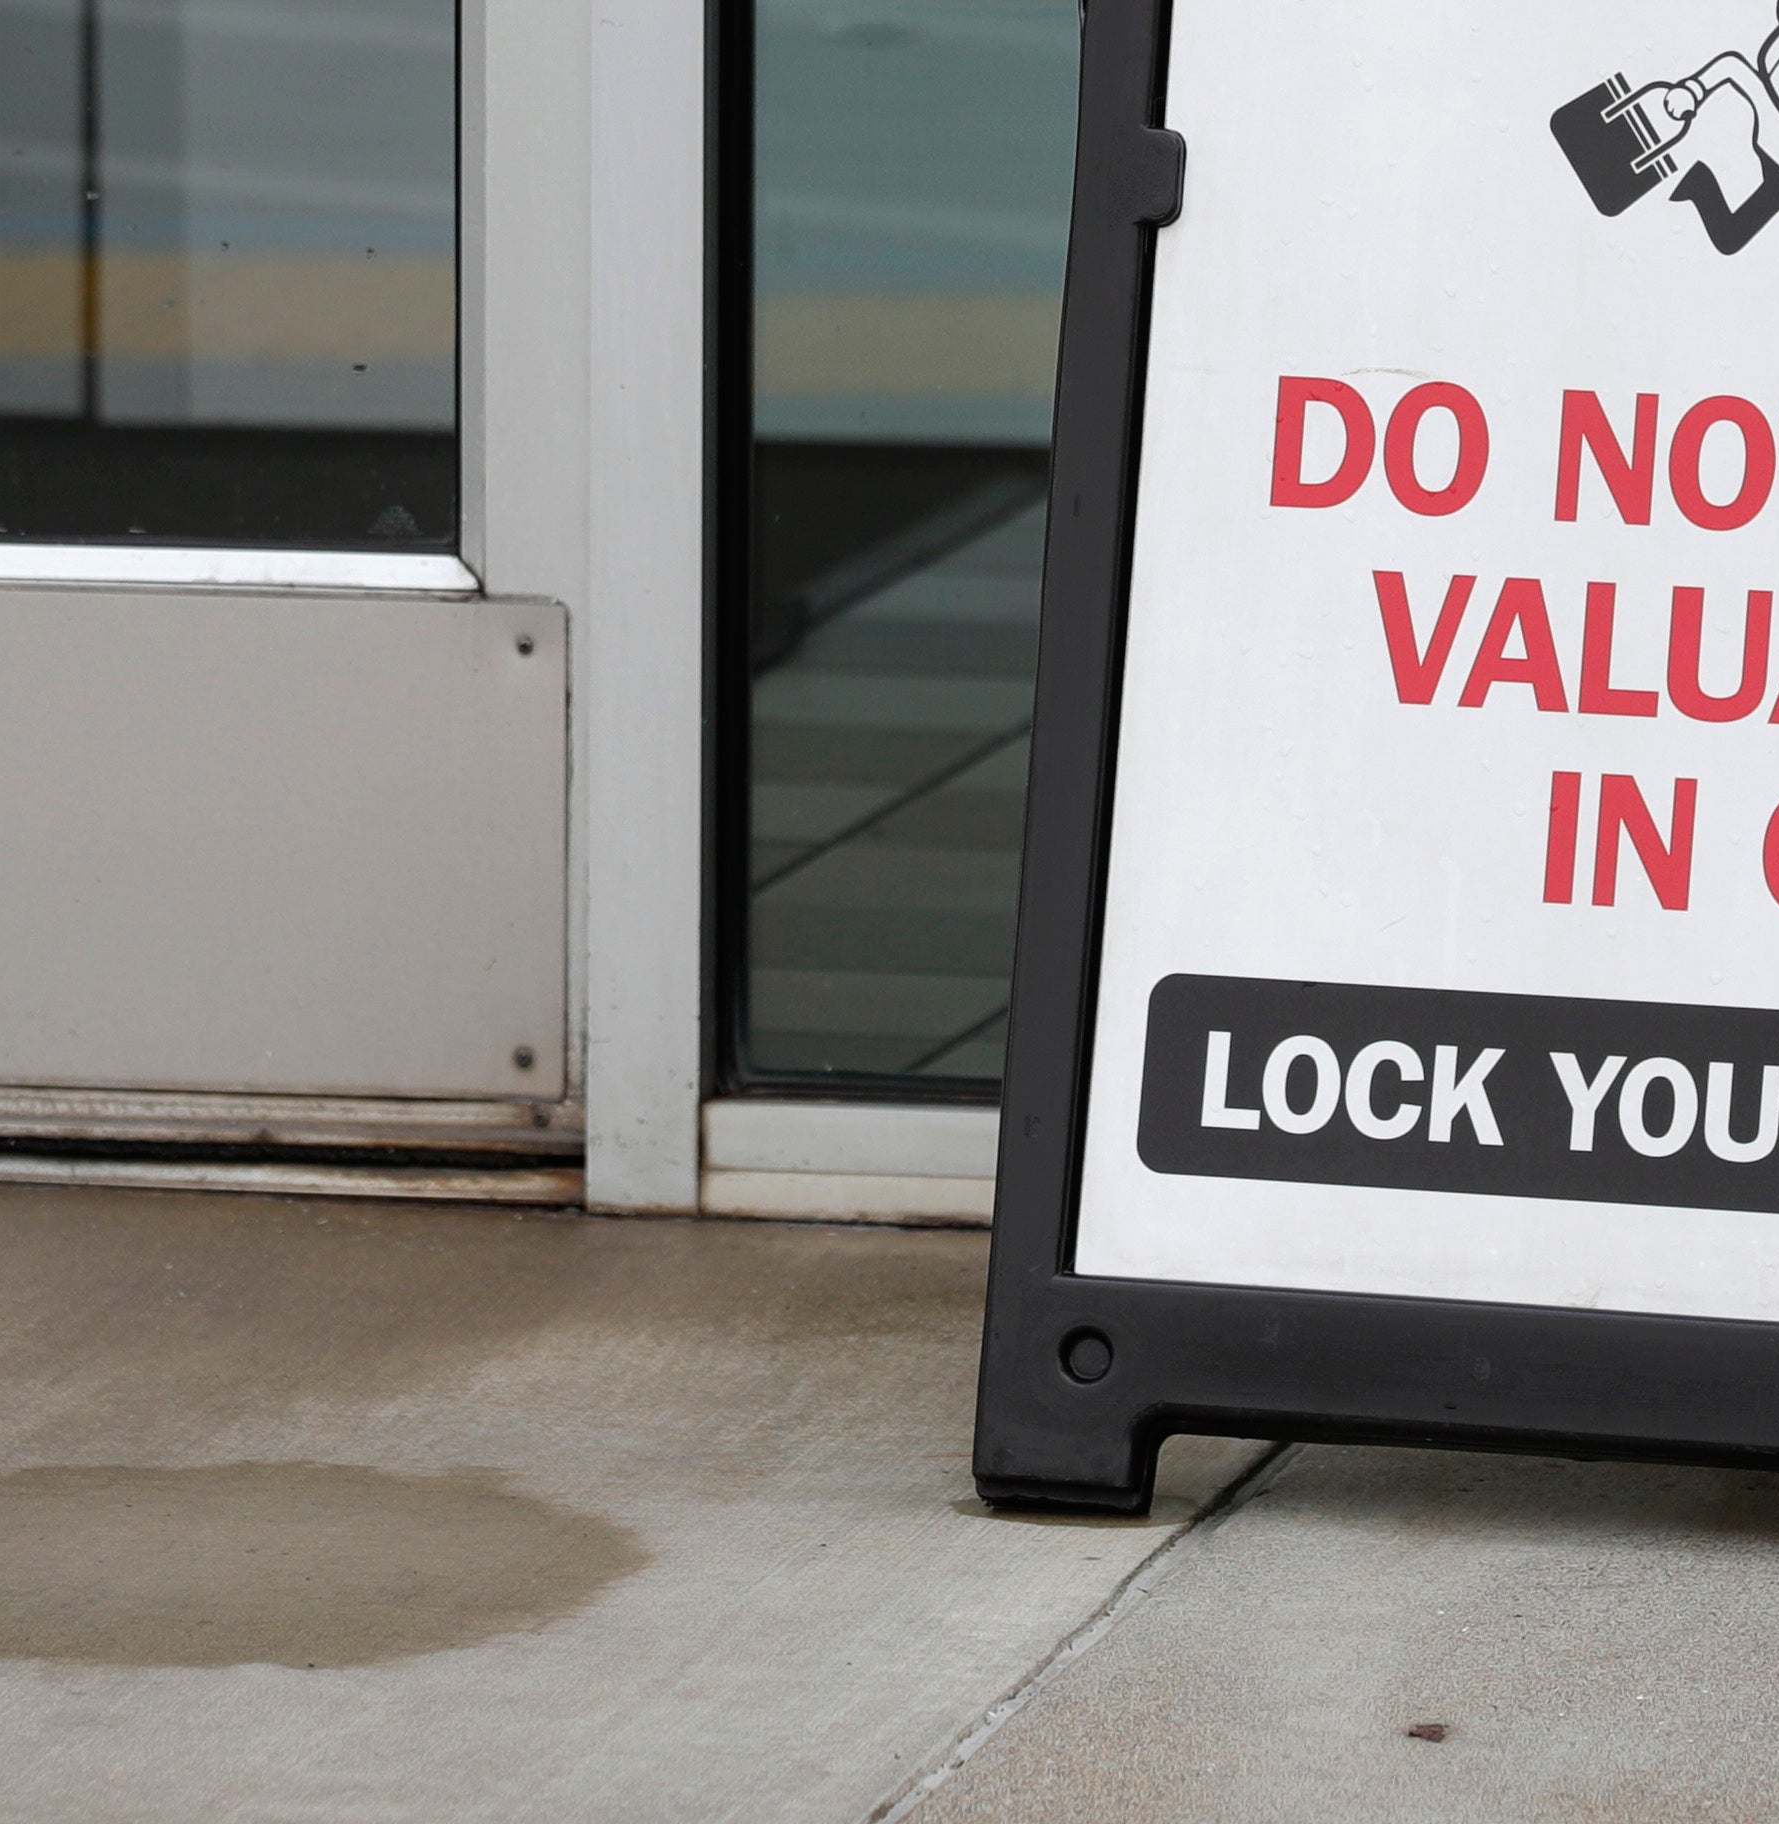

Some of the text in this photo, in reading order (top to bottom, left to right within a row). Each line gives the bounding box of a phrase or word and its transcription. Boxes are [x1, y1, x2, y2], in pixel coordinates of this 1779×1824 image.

[1269, 375, 1491, 518] DO
[1542, 770, 1699, 912] IN
[1199, 1029, 1507, 1147] LOCK
